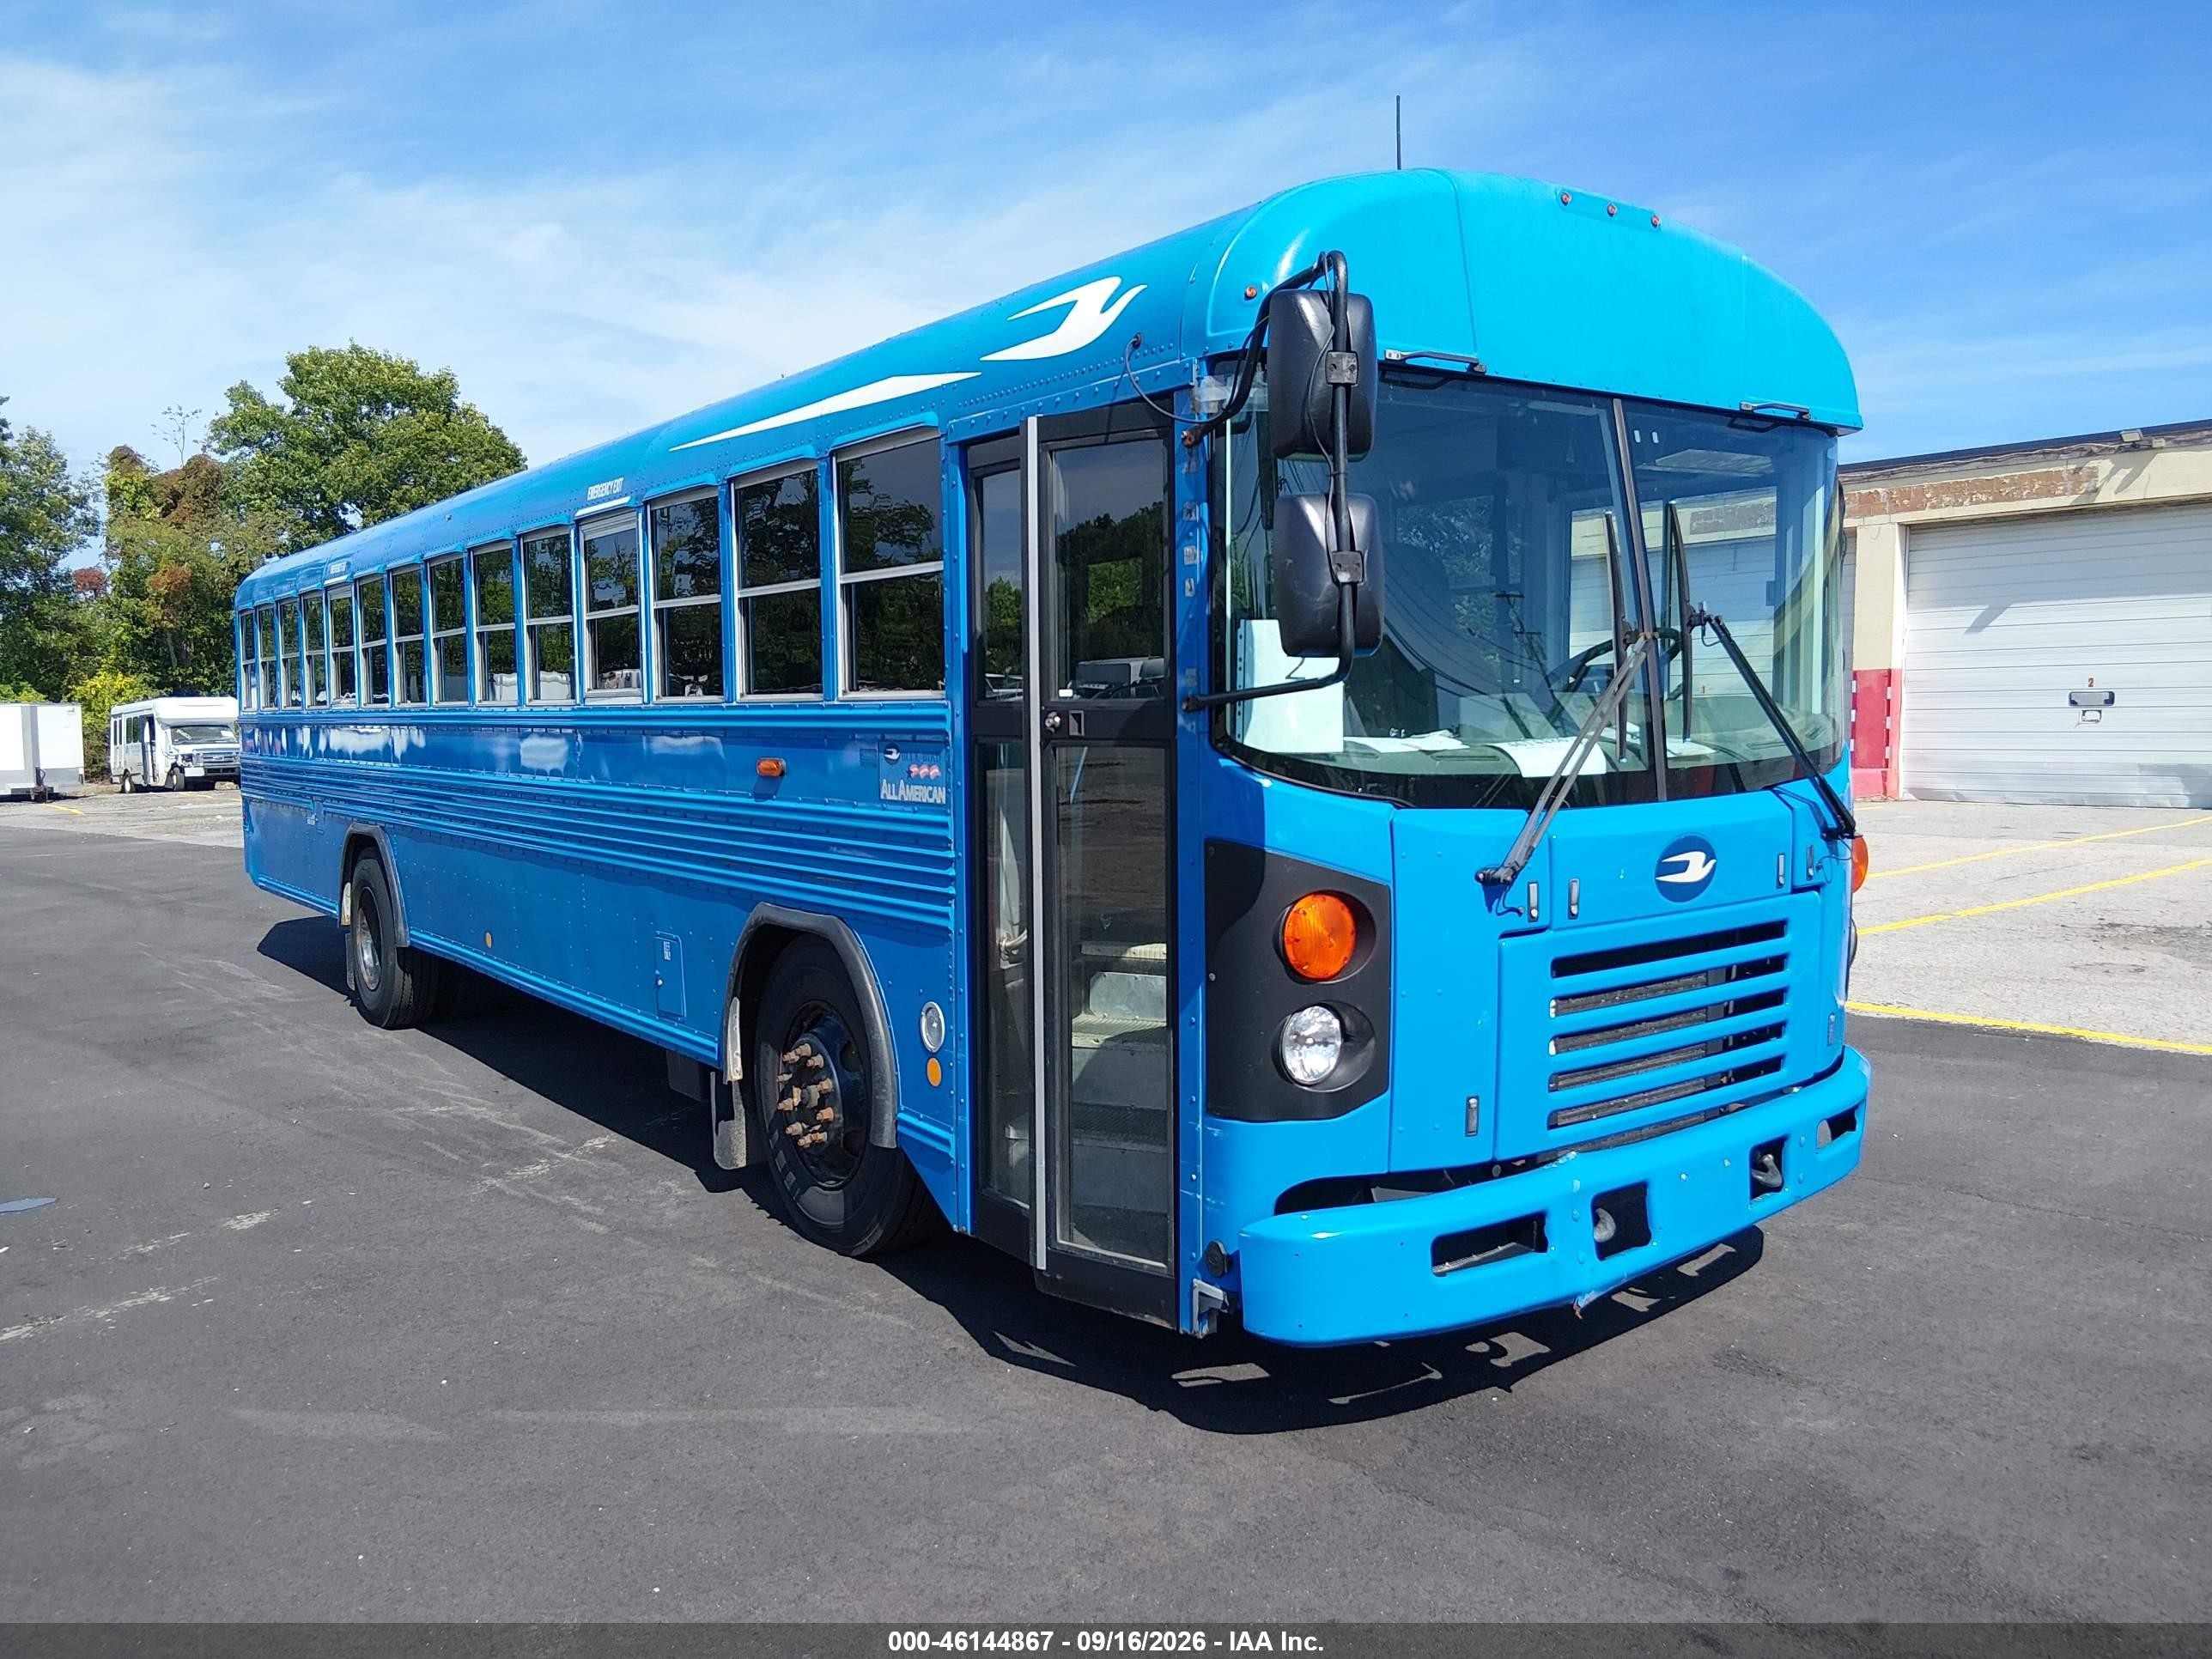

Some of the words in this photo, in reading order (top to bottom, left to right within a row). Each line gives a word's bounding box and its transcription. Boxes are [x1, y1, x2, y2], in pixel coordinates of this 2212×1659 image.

[587, 480, 613, 501] EMERGENCY
[612, 477, 624, 495] EXIT
[2087, 678, 2094, 688] 2
